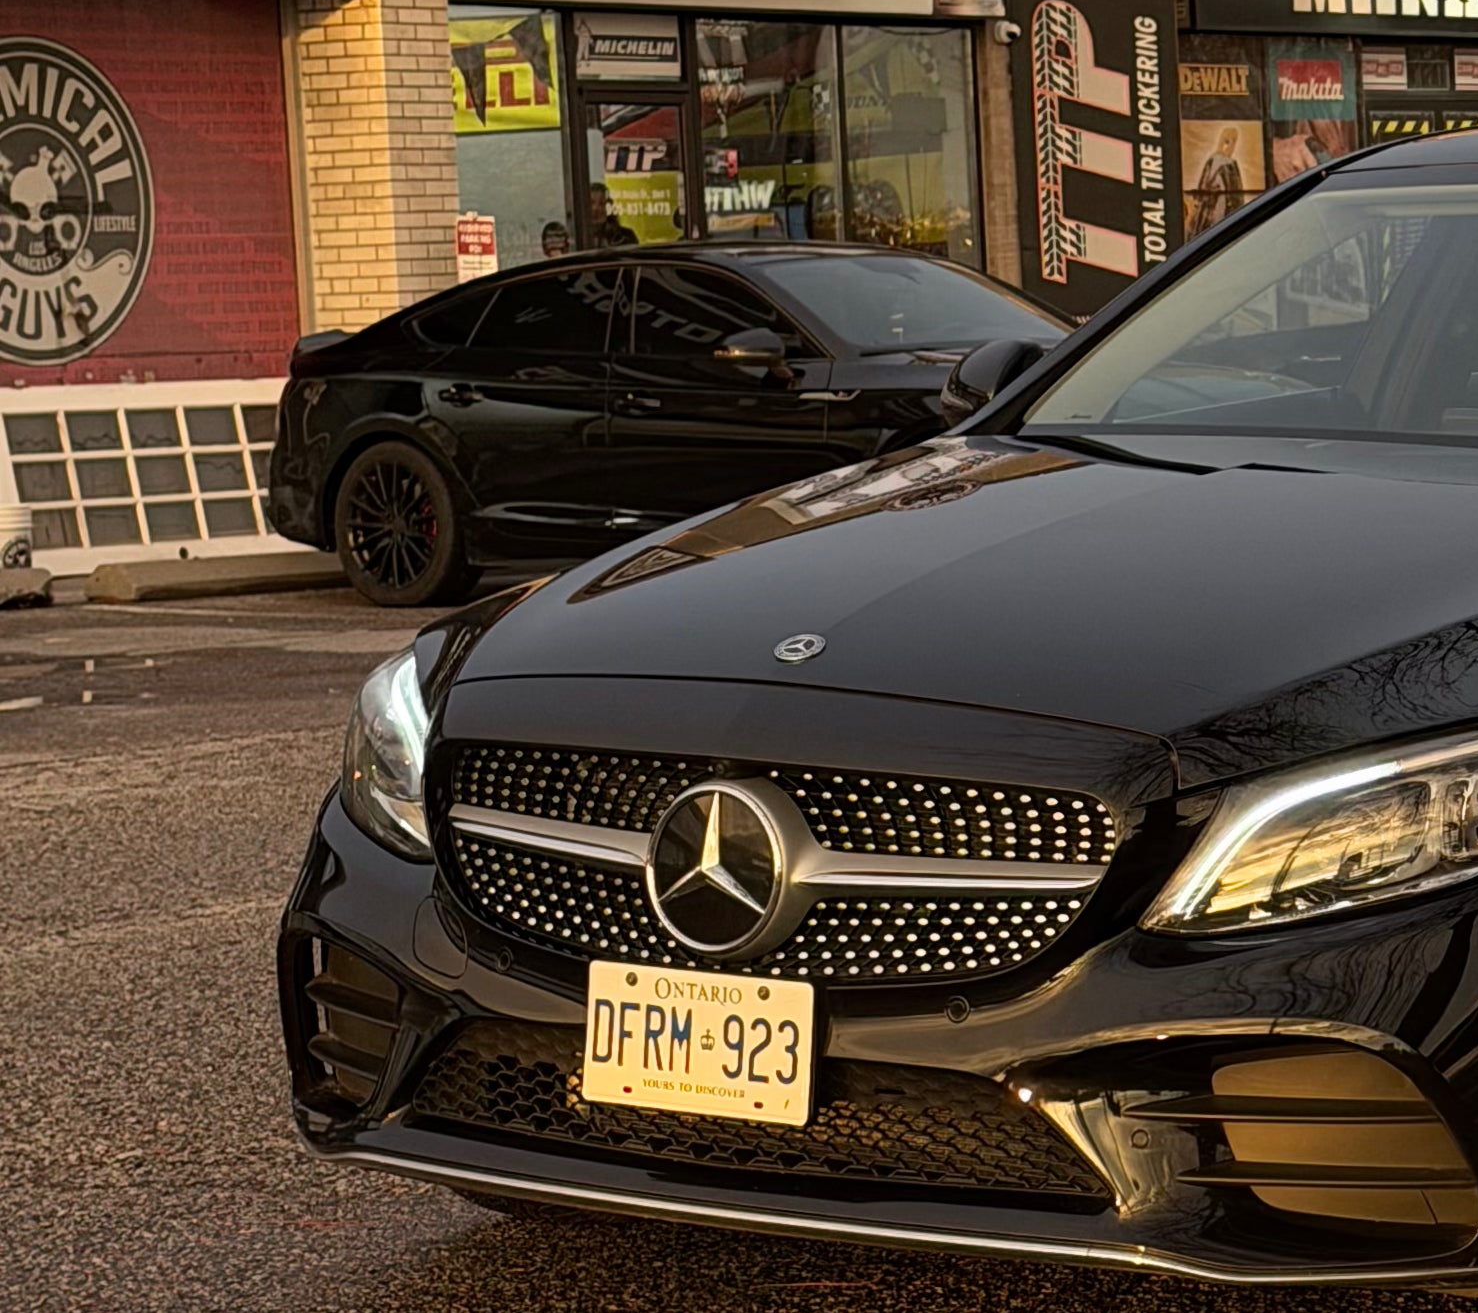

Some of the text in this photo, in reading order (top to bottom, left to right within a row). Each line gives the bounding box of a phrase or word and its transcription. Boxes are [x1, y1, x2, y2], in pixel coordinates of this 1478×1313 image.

[595, 38, 675, 57] MICHELIN
[1134, 15, 1167, 263] TOTAL TIRE PICKERING
[94, 214, 136, 233] LIFESTYLE
[28, 241, 46, 255] LOS
[654, 977, 743, 1006] ONTARIO
[592, 998, 800, 1085] DFRM 923
[642, 1078, 745, 1099] YOURS TO DISCOVER
